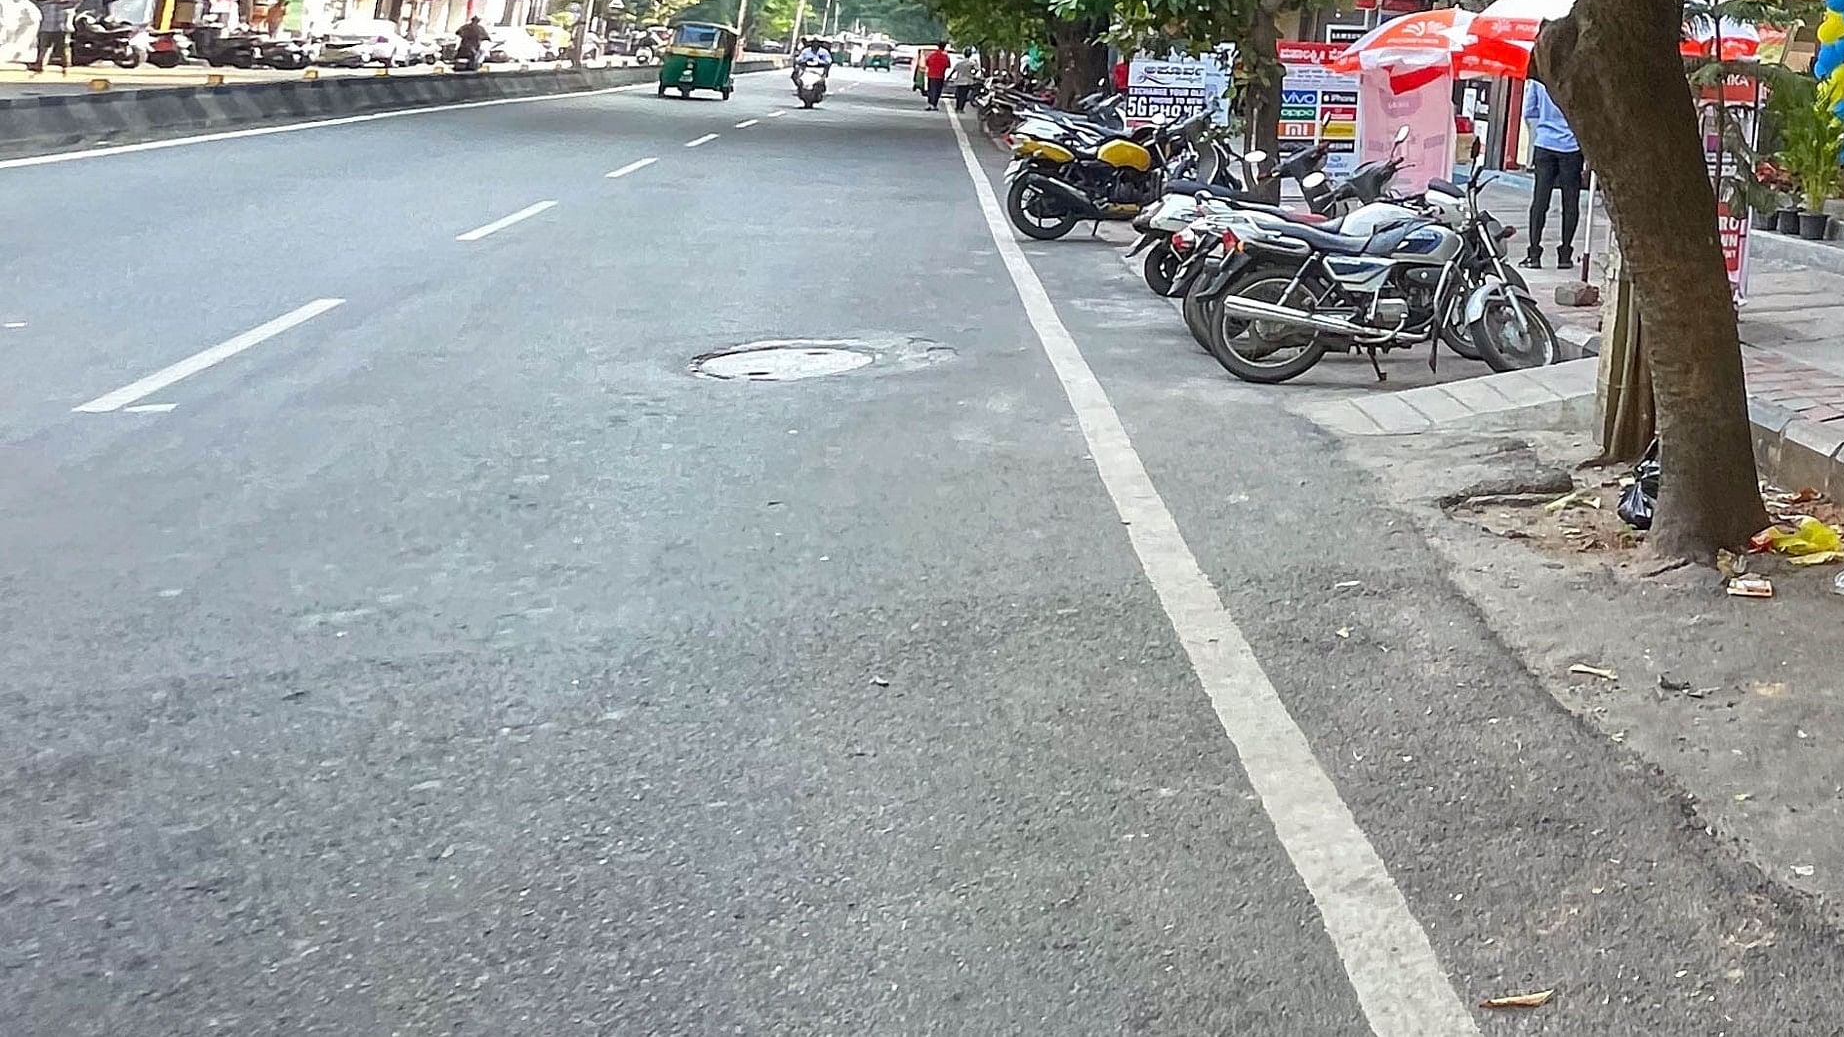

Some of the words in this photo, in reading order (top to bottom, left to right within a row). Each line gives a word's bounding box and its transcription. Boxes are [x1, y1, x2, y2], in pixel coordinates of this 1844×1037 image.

[1282, 91, 1316, 104] vivo
[1127, 96, 1147, 116] 5G
[1280, 109, 1315, 118] oppo
